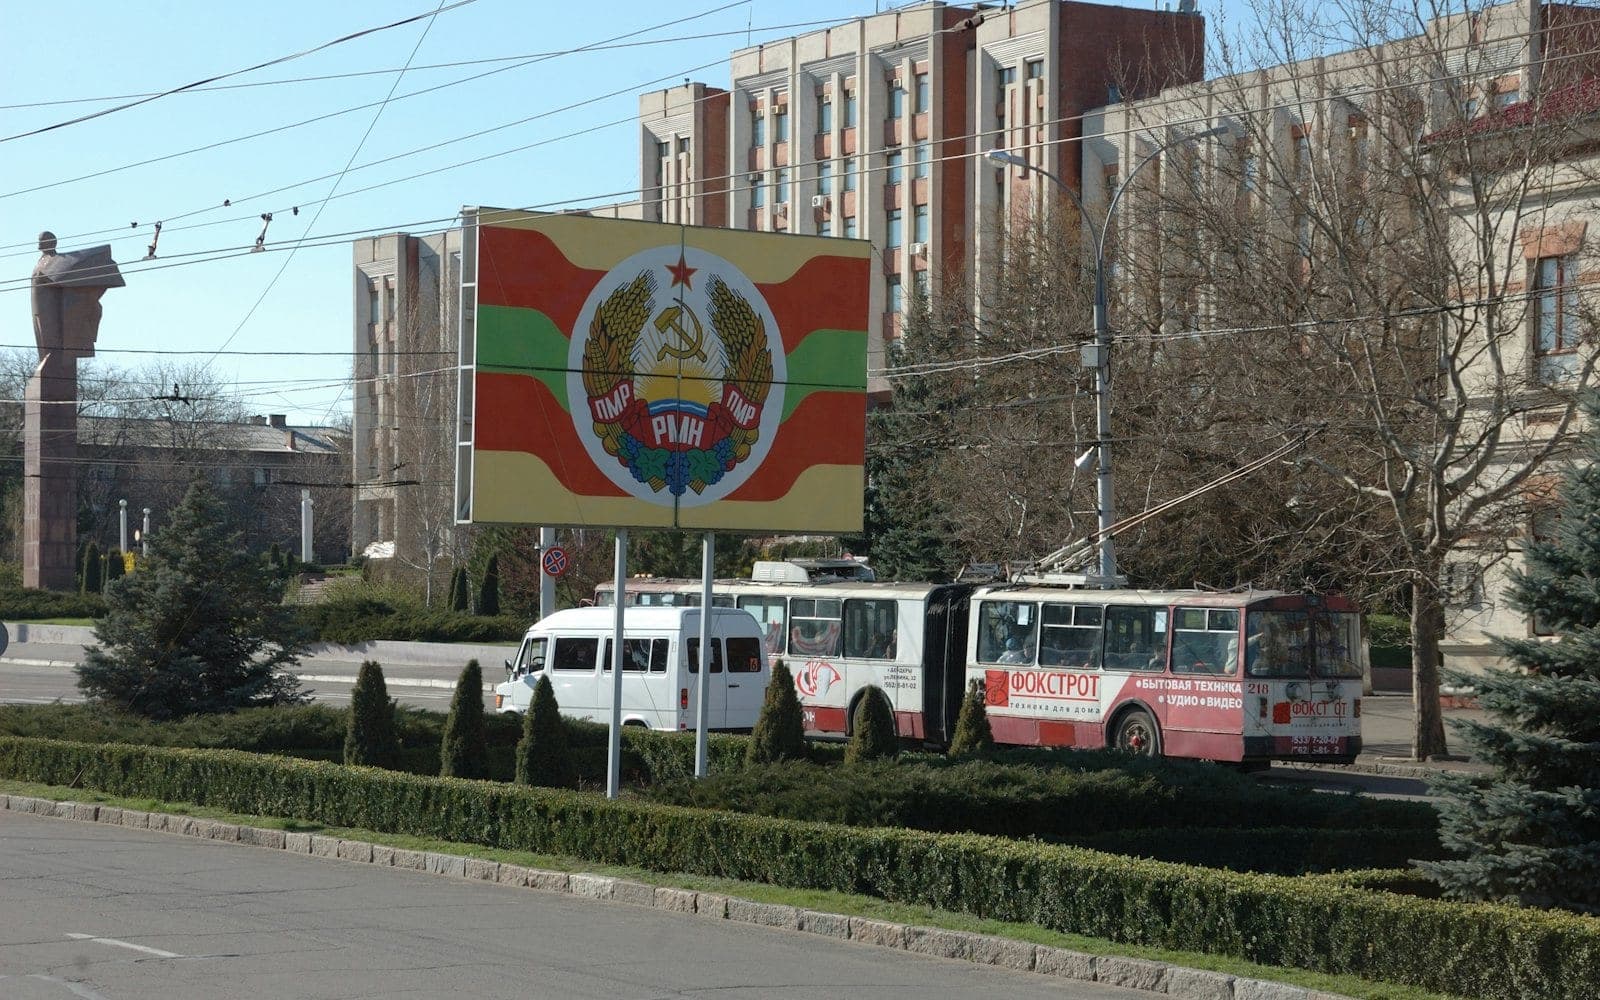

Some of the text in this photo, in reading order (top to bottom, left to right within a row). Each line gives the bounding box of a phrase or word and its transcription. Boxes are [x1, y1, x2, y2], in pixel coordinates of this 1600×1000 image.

[595, 384, 630, 420] ПМР
[726, 390, 756, 426] ПМР
[651, 414, 704, 447] РМН
[1011, 672, 1099, 696] ФОКСТРОТ
[1142, 679, 1242, 694] БЫТОВАЯ ТЕХНИКА
[1248, 684, 1269, 694] 218
[1206, 698, 1242, 710] ВИДЕО
[1293, 702, 1348, 716] ФОКСТОТ
